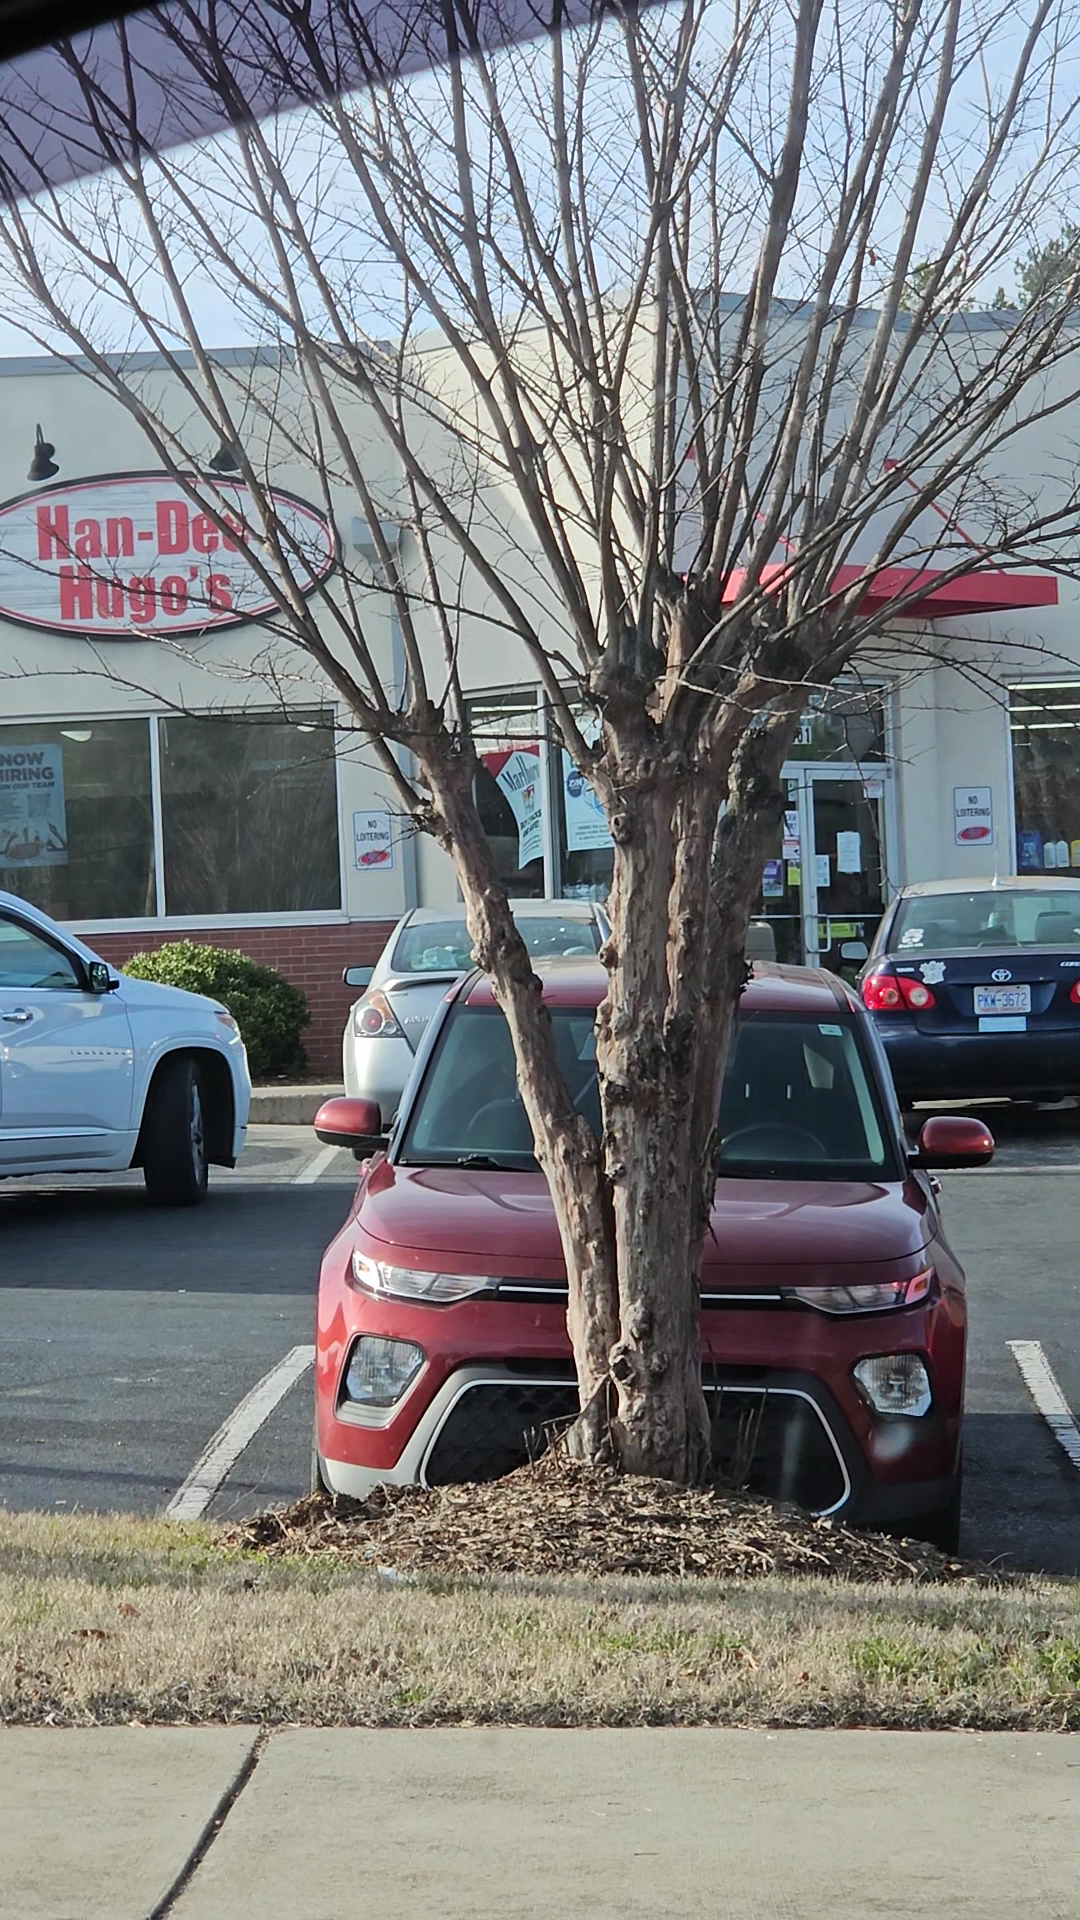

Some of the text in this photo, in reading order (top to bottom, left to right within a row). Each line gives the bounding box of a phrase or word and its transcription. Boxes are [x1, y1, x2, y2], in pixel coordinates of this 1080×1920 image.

[59, 565, 233, 623] Hugo's
[0, 752, 44, 767] NOW
[967, 795, 978, 804] NO
[956, 807, 991, 818] LOITERING
[367, 819, 378, 829] NO
[356, 831, 390, 842] LOITERING
[977, 992, 1028, 1008] PKW-3672
